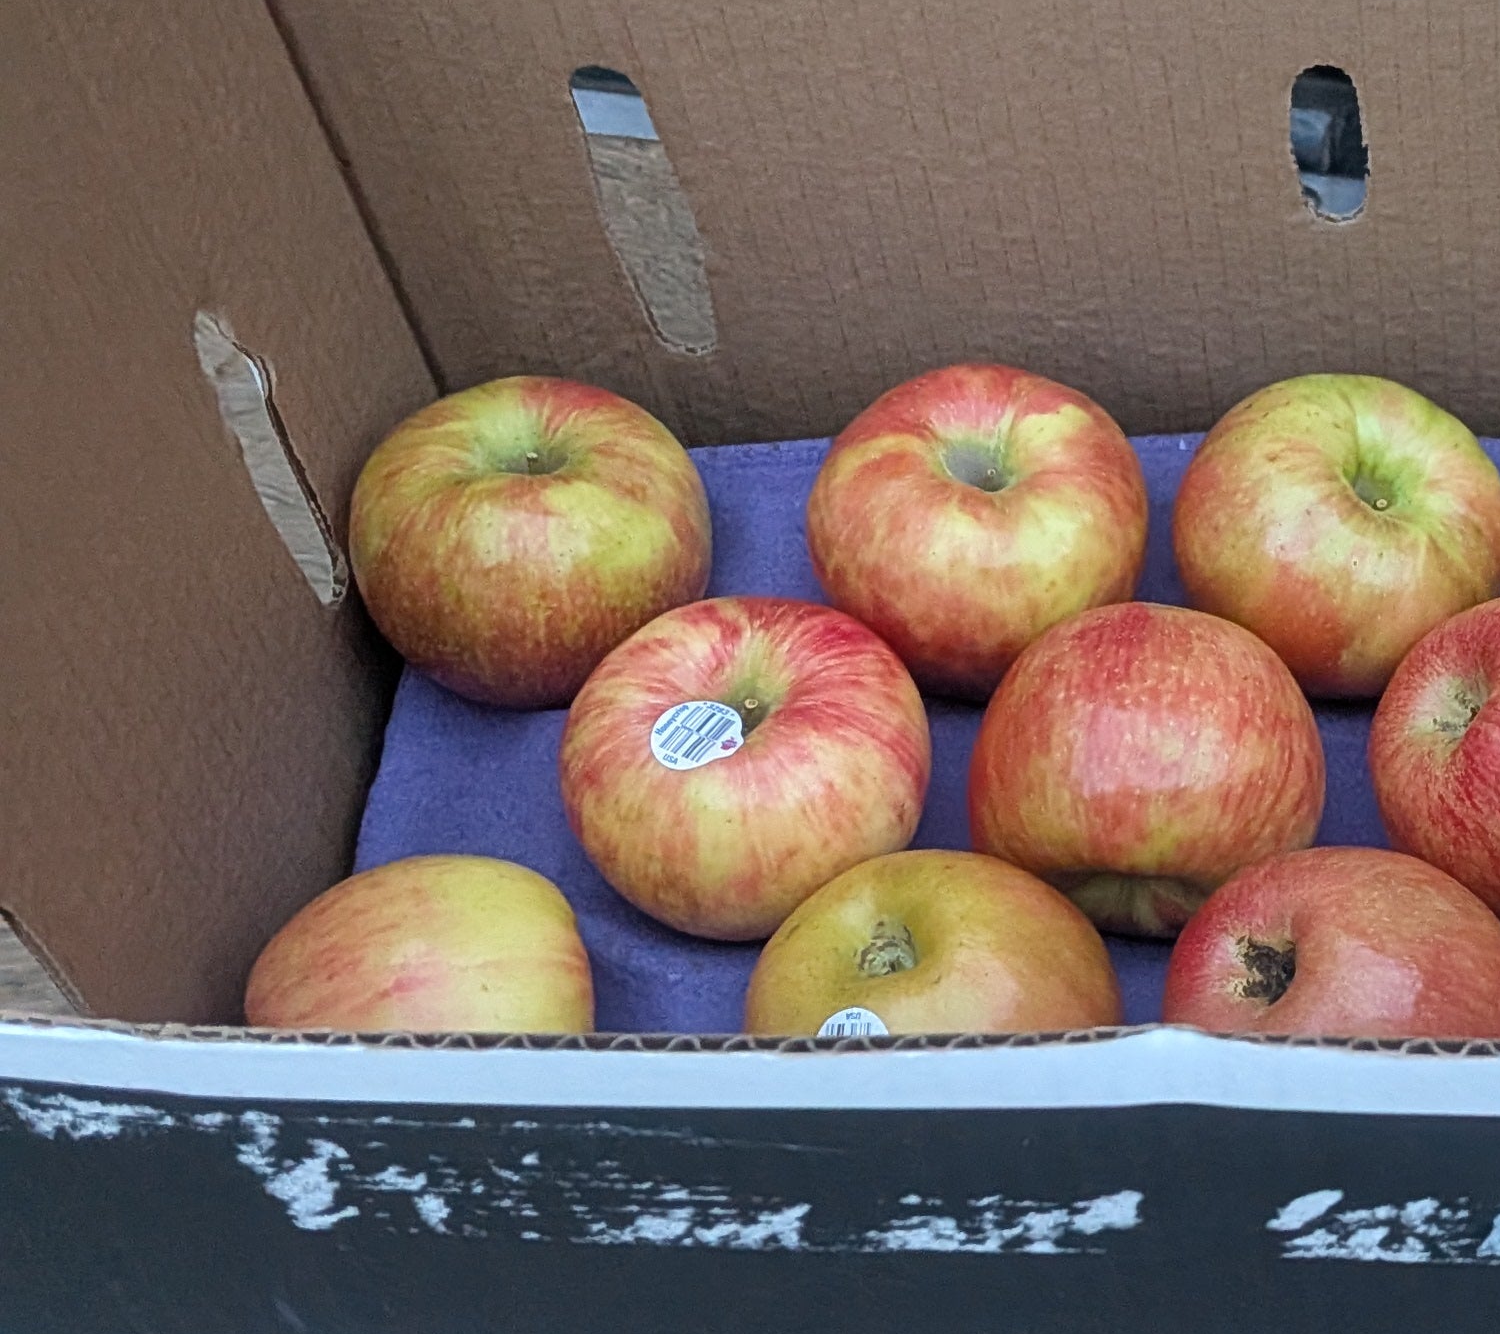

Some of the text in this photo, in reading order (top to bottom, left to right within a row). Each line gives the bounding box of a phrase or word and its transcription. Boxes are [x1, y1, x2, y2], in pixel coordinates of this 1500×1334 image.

[654, 704, 690, 736] Honeycrisp
[662, 753, 679, 765] USA
[845, 1012, 862, 1020] USA
